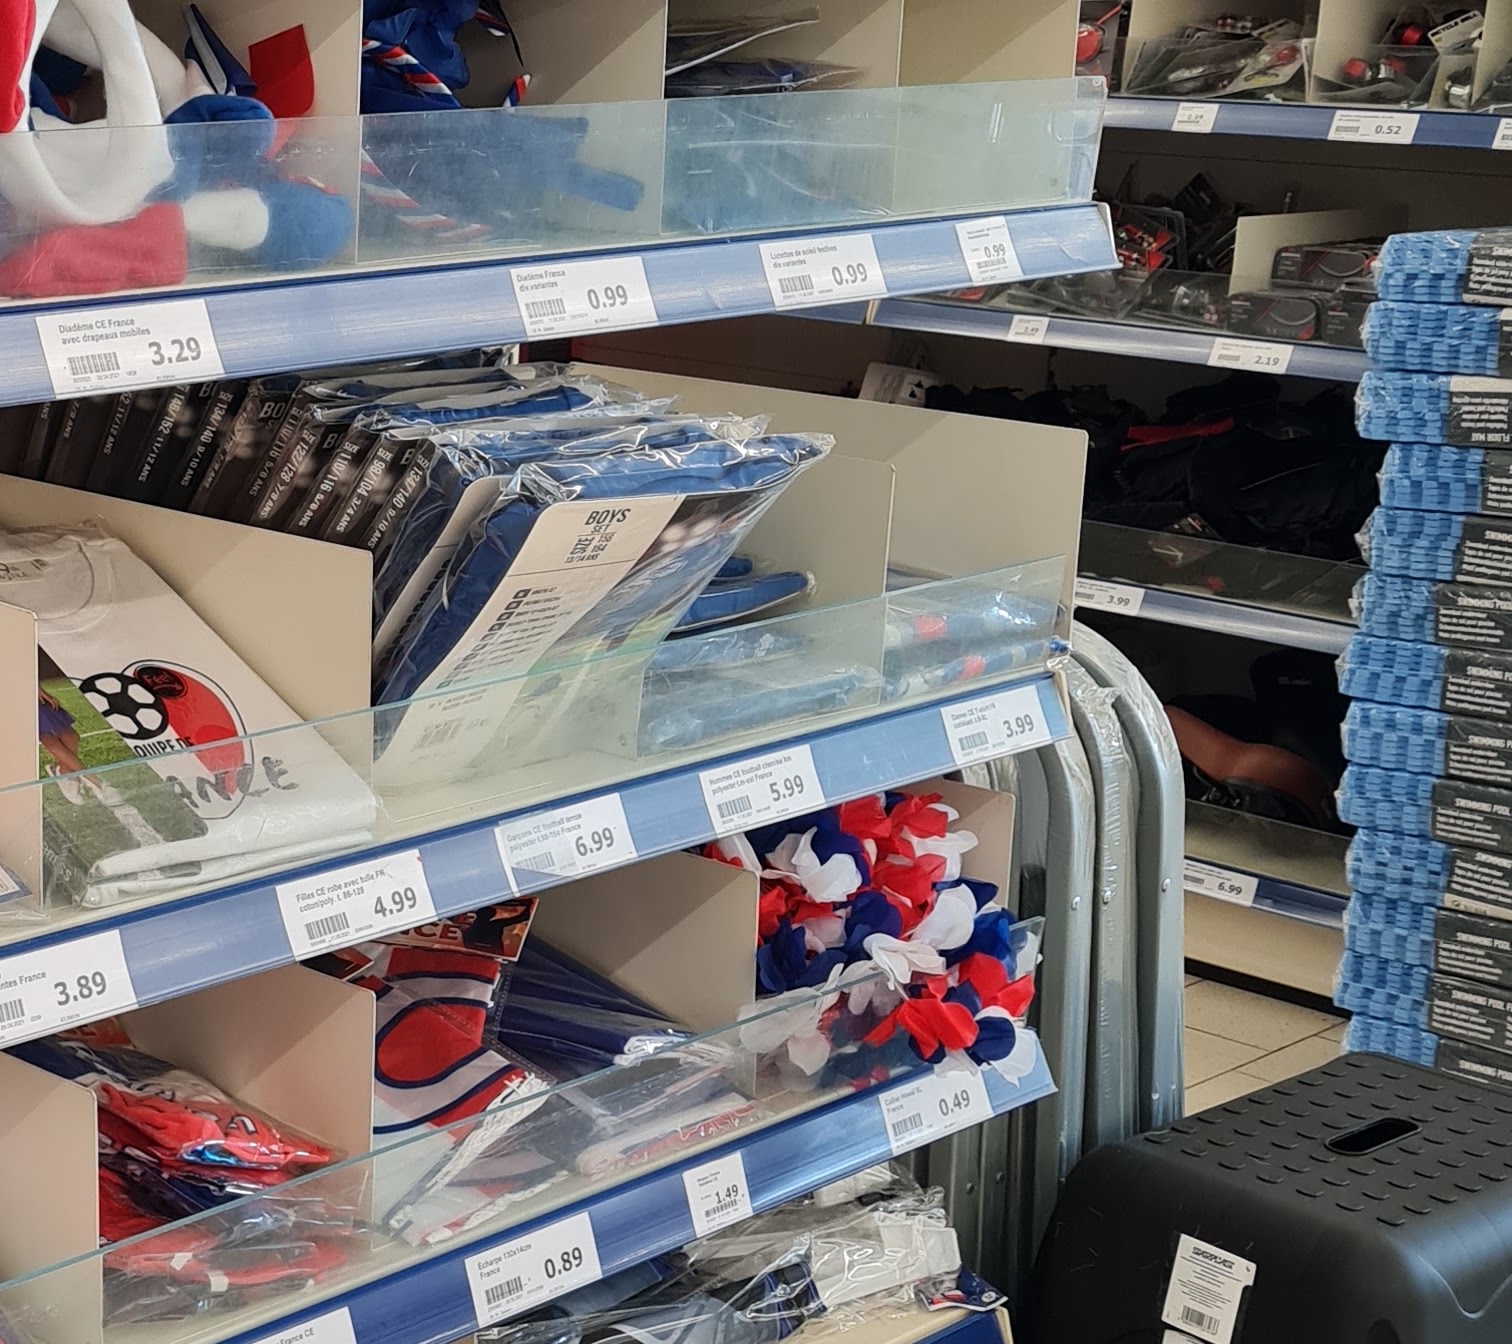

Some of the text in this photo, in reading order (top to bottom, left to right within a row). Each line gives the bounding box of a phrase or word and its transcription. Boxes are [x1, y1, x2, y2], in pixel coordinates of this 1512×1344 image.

[1374, 124, 1402, 136] 0.52
[984, 244, 1006, 259] 0.99
[832, 262, 868, 286] 0.99
[587, 284, 628, 310] 0.99
[58, 318, 135, 335] Diadème CE France
[62, 327, 151, 346] avec drapeaux mobiles
[148, 336, 201, 367] 3.29
[1254, 355, 1280, 367] 2.19
[260, 499, 276, 519] ANS
[585, 508, 631, 526] BOYS
[299, 511, 313, 529] ANS
[337, 511, 355, 534] ANS
[591, 524, 610, 533] SET
[367, 529, 382, 549] ANS
[569, 535, 594, 555] SIZE
[1107, 595, 1130, 607] 3.99
[1003, 714, 1034, 739] 3.99
[135, 740, 176, 757] QUIPE
[769, 774, 804, 802] 5.99
[575, 826, 614, 856] 6.99
[296, 892, 315, 903] Filles
[316, 887, 326, 897] CE
[327, 883, 343, 894] robe
[344, 879, 359, 890] avec
[375, 868, 385, 879] FR
[1217, 881, 1243, 896] 6.99
[374, 886, 417, 918] 4.99
[19, 970, 47, 985] France
[54, 971, 107, 1007] 3.89
[938, 1089, 971, 1118] 0.49
[715, 1184, 739, 1206] 1.49
[477, 1256, 502, 1272] Écharpe
[544, 1246, 583, 1279] 0.89
[480, 1266, 501, 1280] France
[304, 1327, 315, 1338] CE
